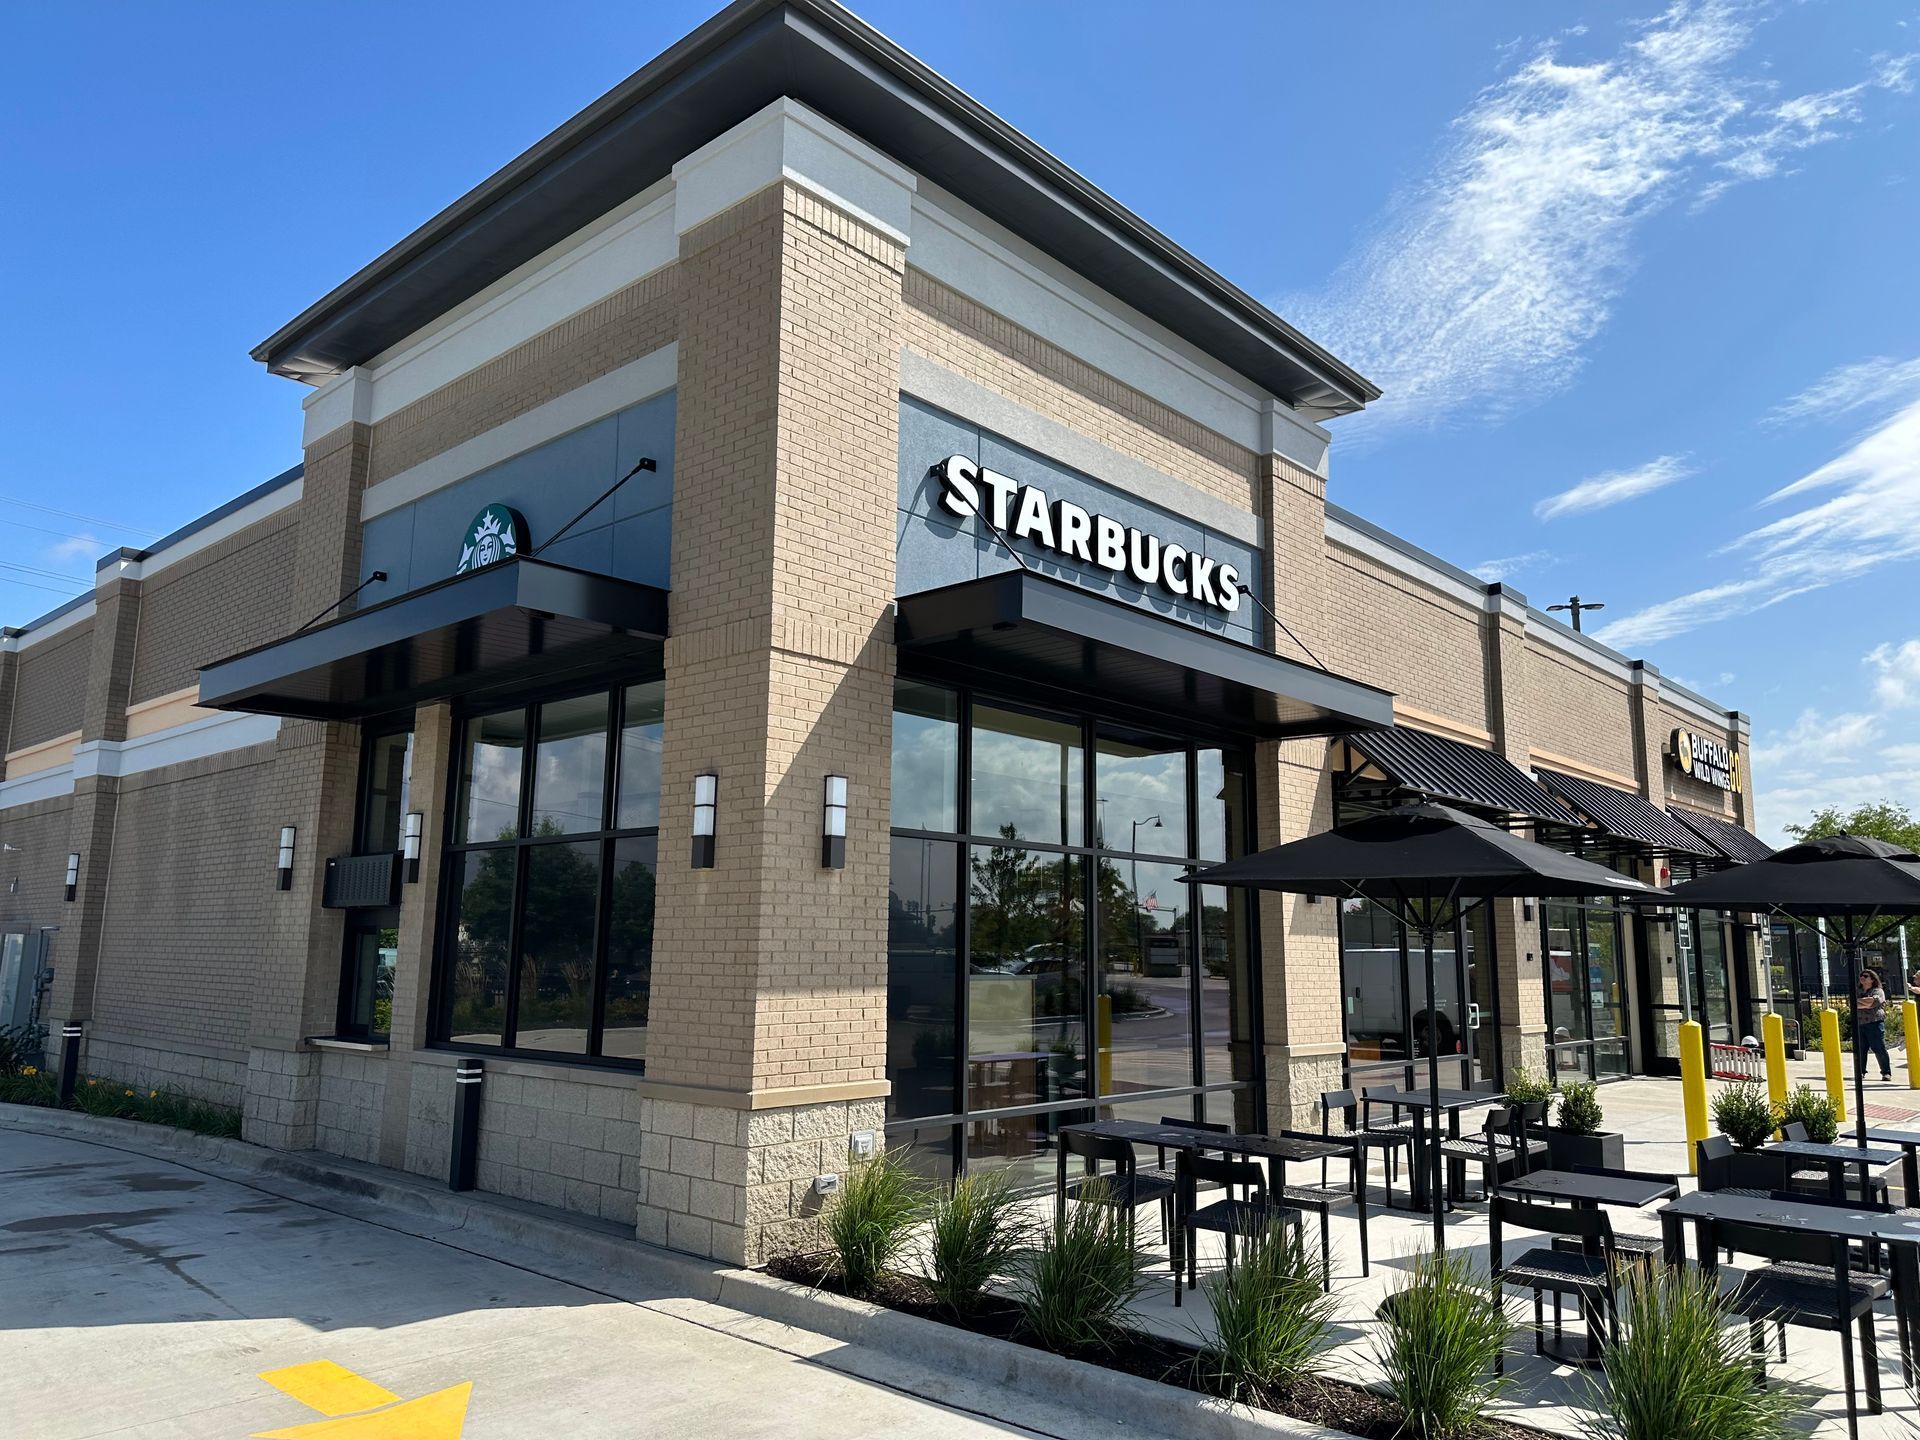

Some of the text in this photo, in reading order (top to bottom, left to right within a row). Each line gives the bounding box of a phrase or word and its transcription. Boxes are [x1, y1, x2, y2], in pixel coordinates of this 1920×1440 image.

[945, 454, 1240, 612] STARBUCKS
[1691, 733, 1729, 771] BUFFALO
[1729, 749, 1742, 794] GO
[1693, 760, 1730, 791] WILD WINGS
